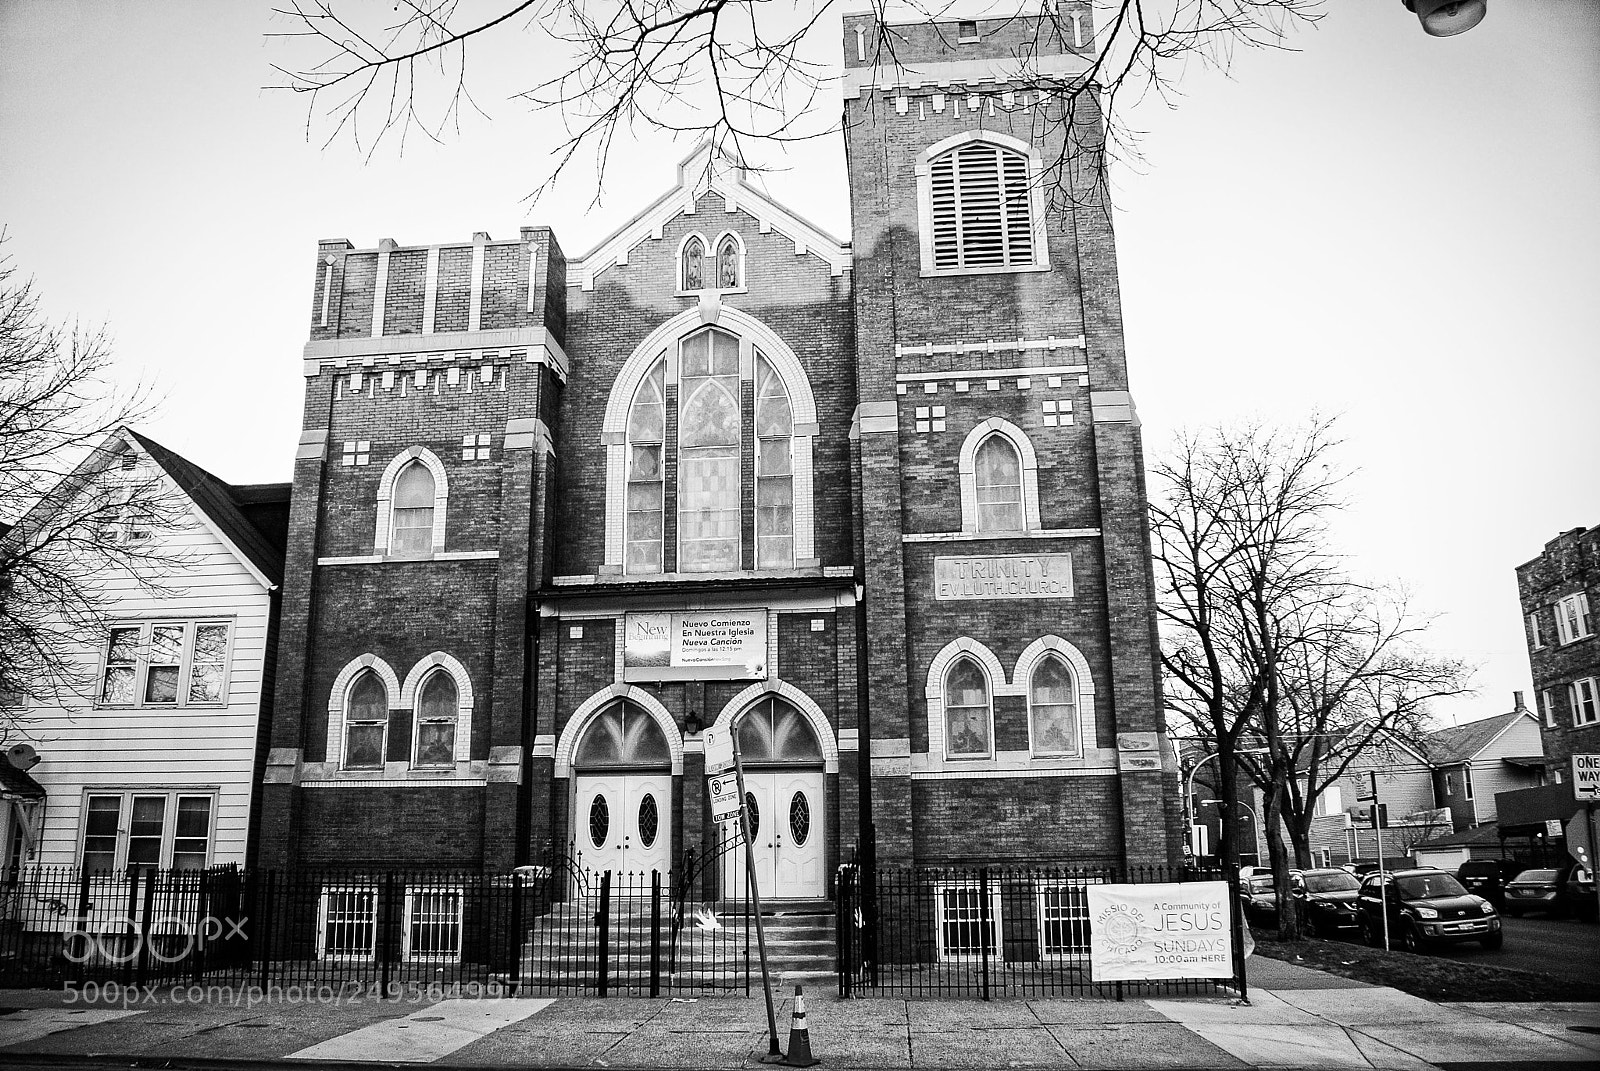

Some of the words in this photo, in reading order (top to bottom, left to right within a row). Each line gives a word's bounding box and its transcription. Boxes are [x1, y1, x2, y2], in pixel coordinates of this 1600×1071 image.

[954, 558, 1050, 579] TRINITY
[636, 621, 668, 635] New
[682, 620, 708, 628] Nuevo
[711, 619, 751, 627] Comienzo
[694, 629, 726, 637] Nuestra
[728, 628, 755, 637] Iglesia
[710, 638, 743, 646] Canción
[1577, 757, 1600, 769] ONE
[1578, 771, 1600, 782] WAY
[714, 813, 725, 822] TOW
[726, 810, 740, 819] ZONE
[1153, 903, 1160, 911] A
[1162, 902, 1210, 911] Community
[1212, 901, 1221, 909] of
[1096, 903, 1128, 925] MISSIO
[1153, 912, 1222, 932] JESUS
[1101, 939, 1143, 955] CHICAGO
[1153, 938, 1226, 953] SUNDAYS
[1201, 954, 1226, 963] HERE
